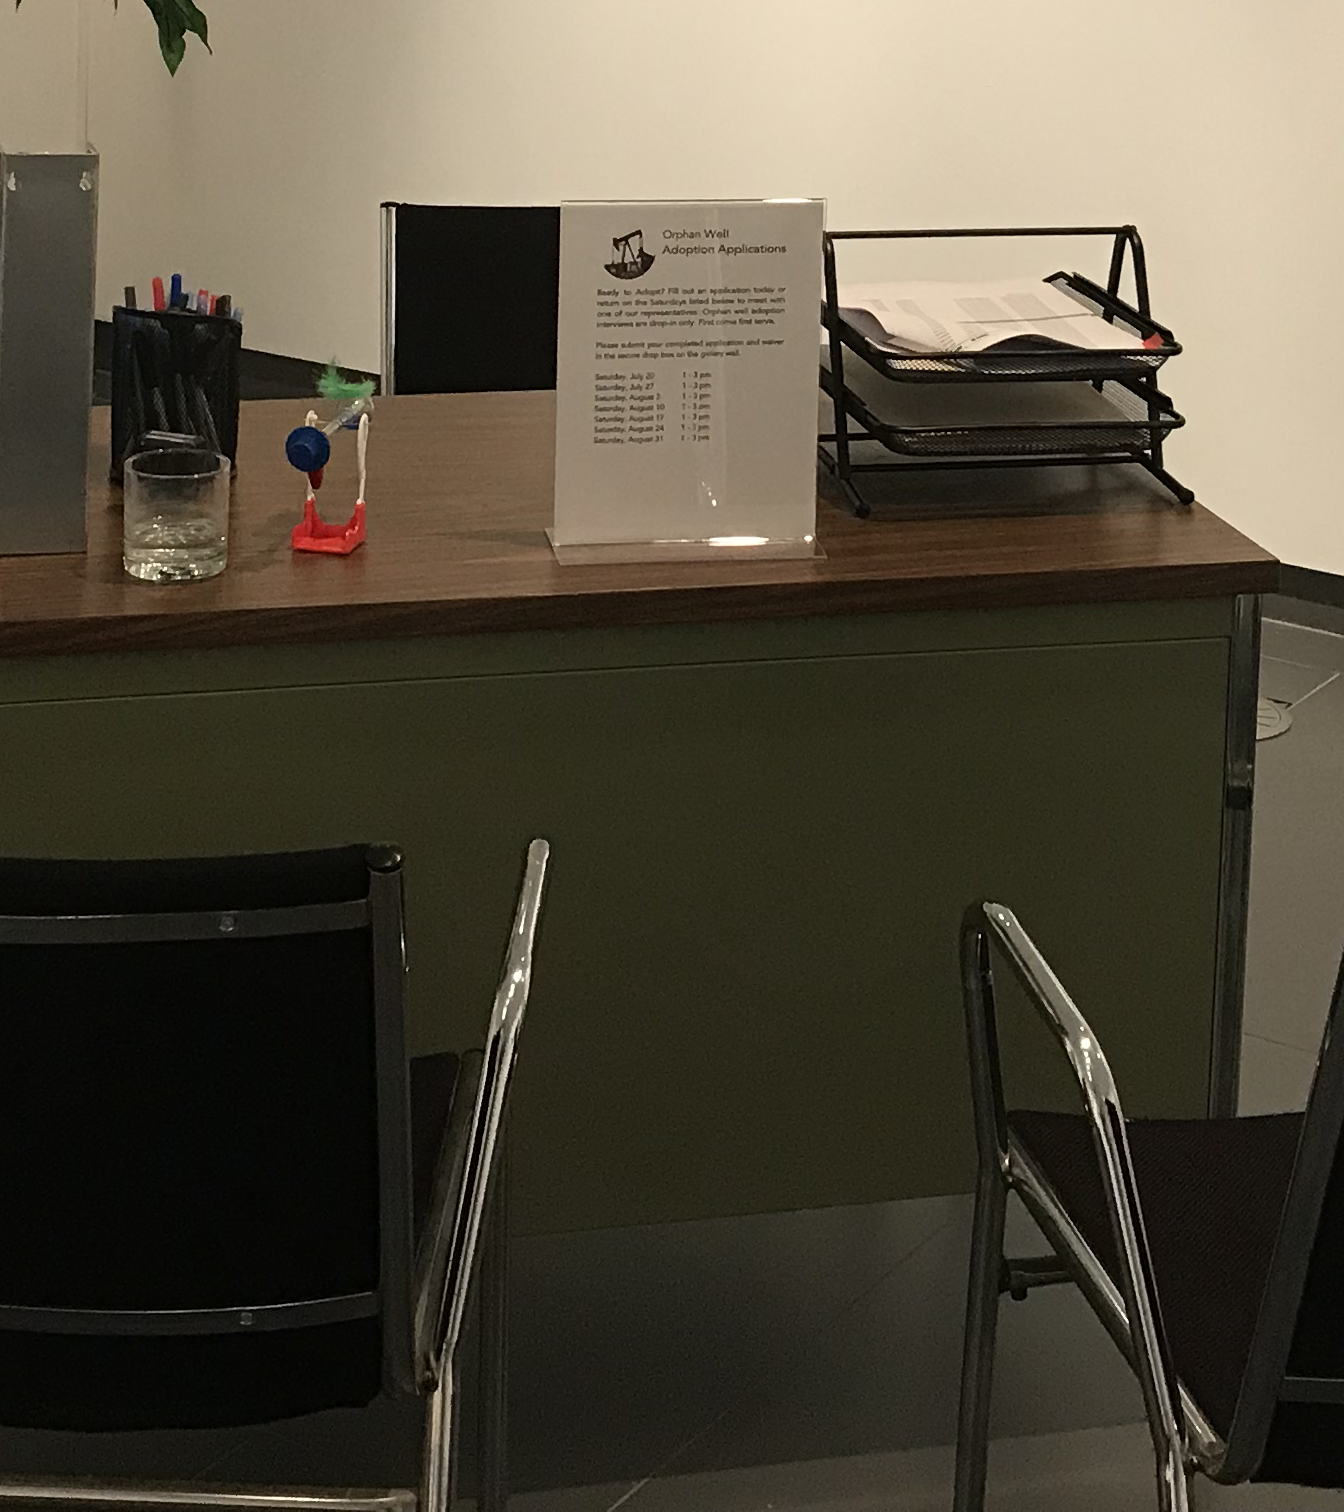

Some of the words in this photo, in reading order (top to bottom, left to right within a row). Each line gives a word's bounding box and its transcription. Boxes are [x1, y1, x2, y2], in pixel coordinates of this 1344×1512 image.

[662, 229, 702, 242] Orphan
[703, 228, 730, 239] Well
[661, 245, 715, 257] Adoption
[717, 244, 787, 256] Applications
[635, 288, 666, 297] Adopt?
[710, 286, 751, 296] application
[635, 298, 648, 306] the
[614, 309, 624, 317] of
[702, 308, 732, 317] Orphan
[751, 307, 786, 316] adoption
[647, 341, 663, 350] your
[746, 338, 761, 346] and
[687, 350, 699, 358] the
[629, 372, 644, 382] July
[645, 371, 656, 380] 20
[699, 372, 712, 380] pm
[629, 382, 644, 392] July
[644, 382, 655, 390] 27
[699, 383, 712, 391] pm
[628, 394, 655, 402] August
[699, 393, 712, 401] pm
[629, 404, 654, 413] August
[656, 403, 666, 411] 10
[698, 404, 712, 412] pm
[628, 415, 654, 423] August
[698, 414, 711, 422] pm
[628, 424, 654, 433] August
[655, 424, 665, 432] 24
[698, 424, 710, 432] pm
[628, 435, 654, 444] August
[697, 435, 710, 443] pm
